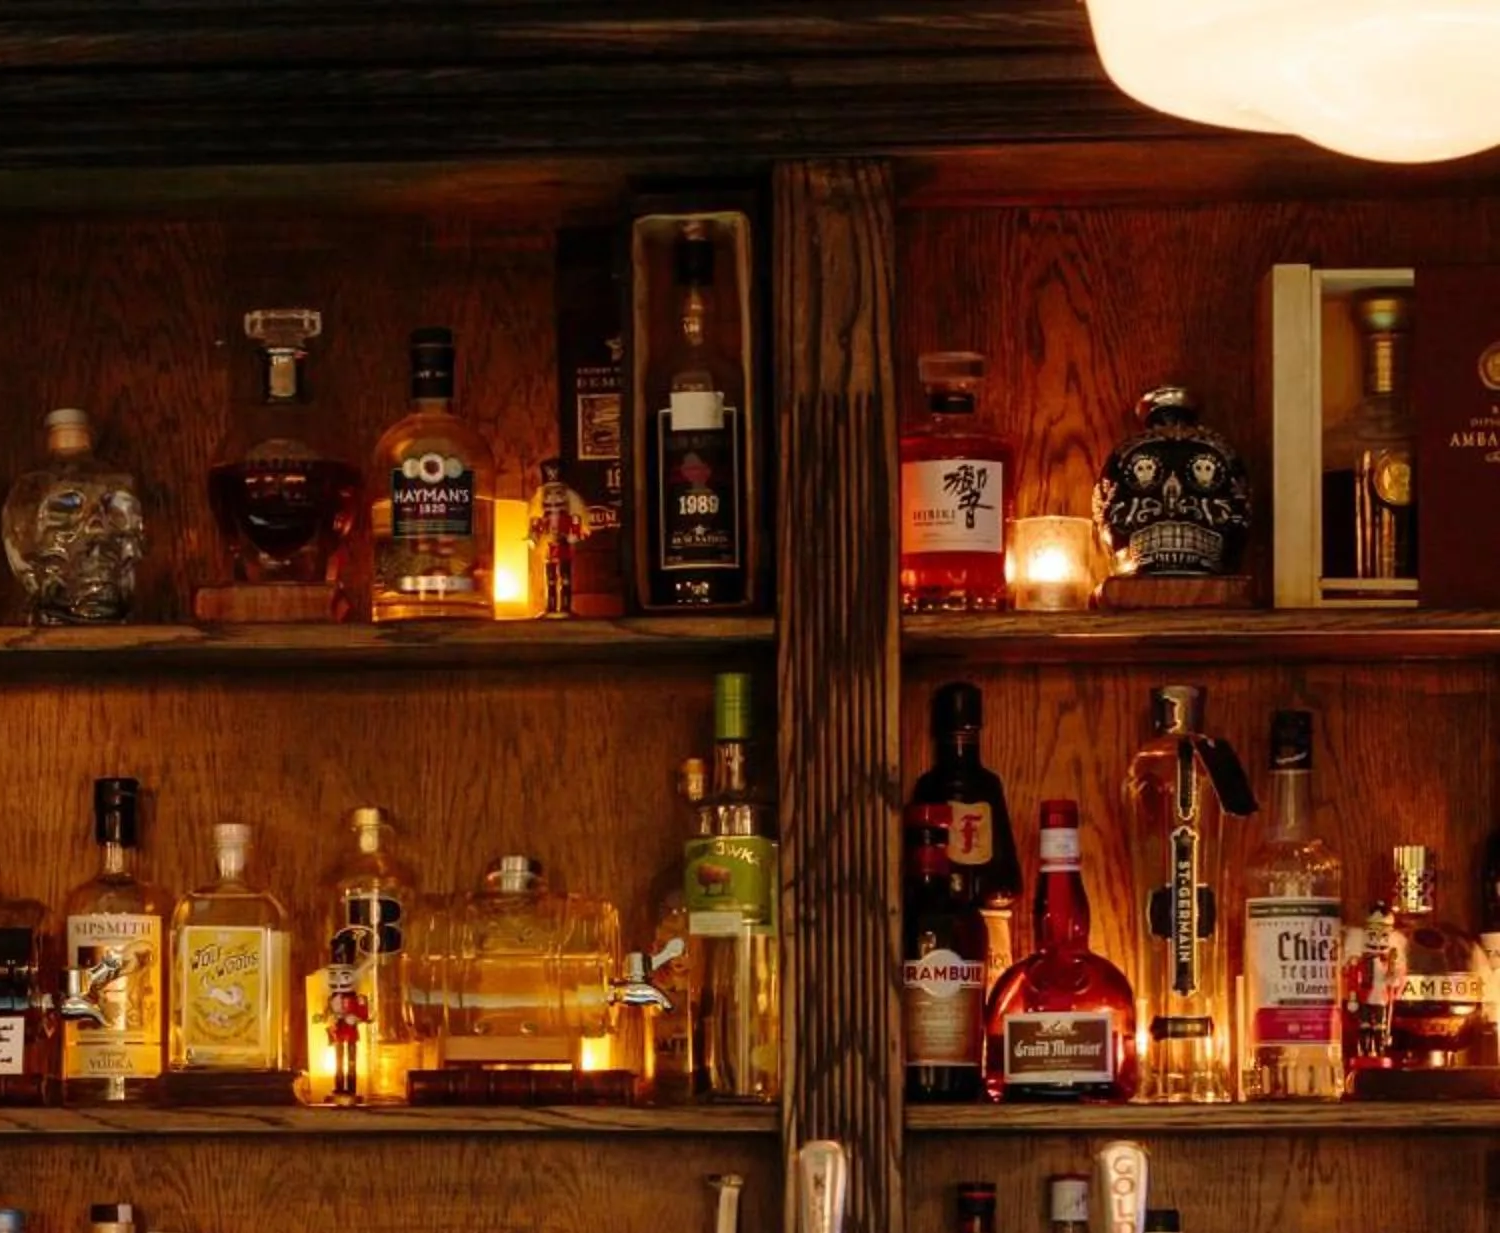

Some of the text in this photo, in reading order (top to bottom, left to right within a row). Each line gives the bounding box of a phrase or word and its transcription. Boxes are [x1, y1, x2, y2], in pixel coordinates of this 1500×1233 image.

[393, 487, 470, 504] HAYMAN'S
[678, 494, 720, 516] 1989
[72, 919, 154, 936] SIPSMITH
[1013, 1039, 1104, 1059] Grand Marnier
